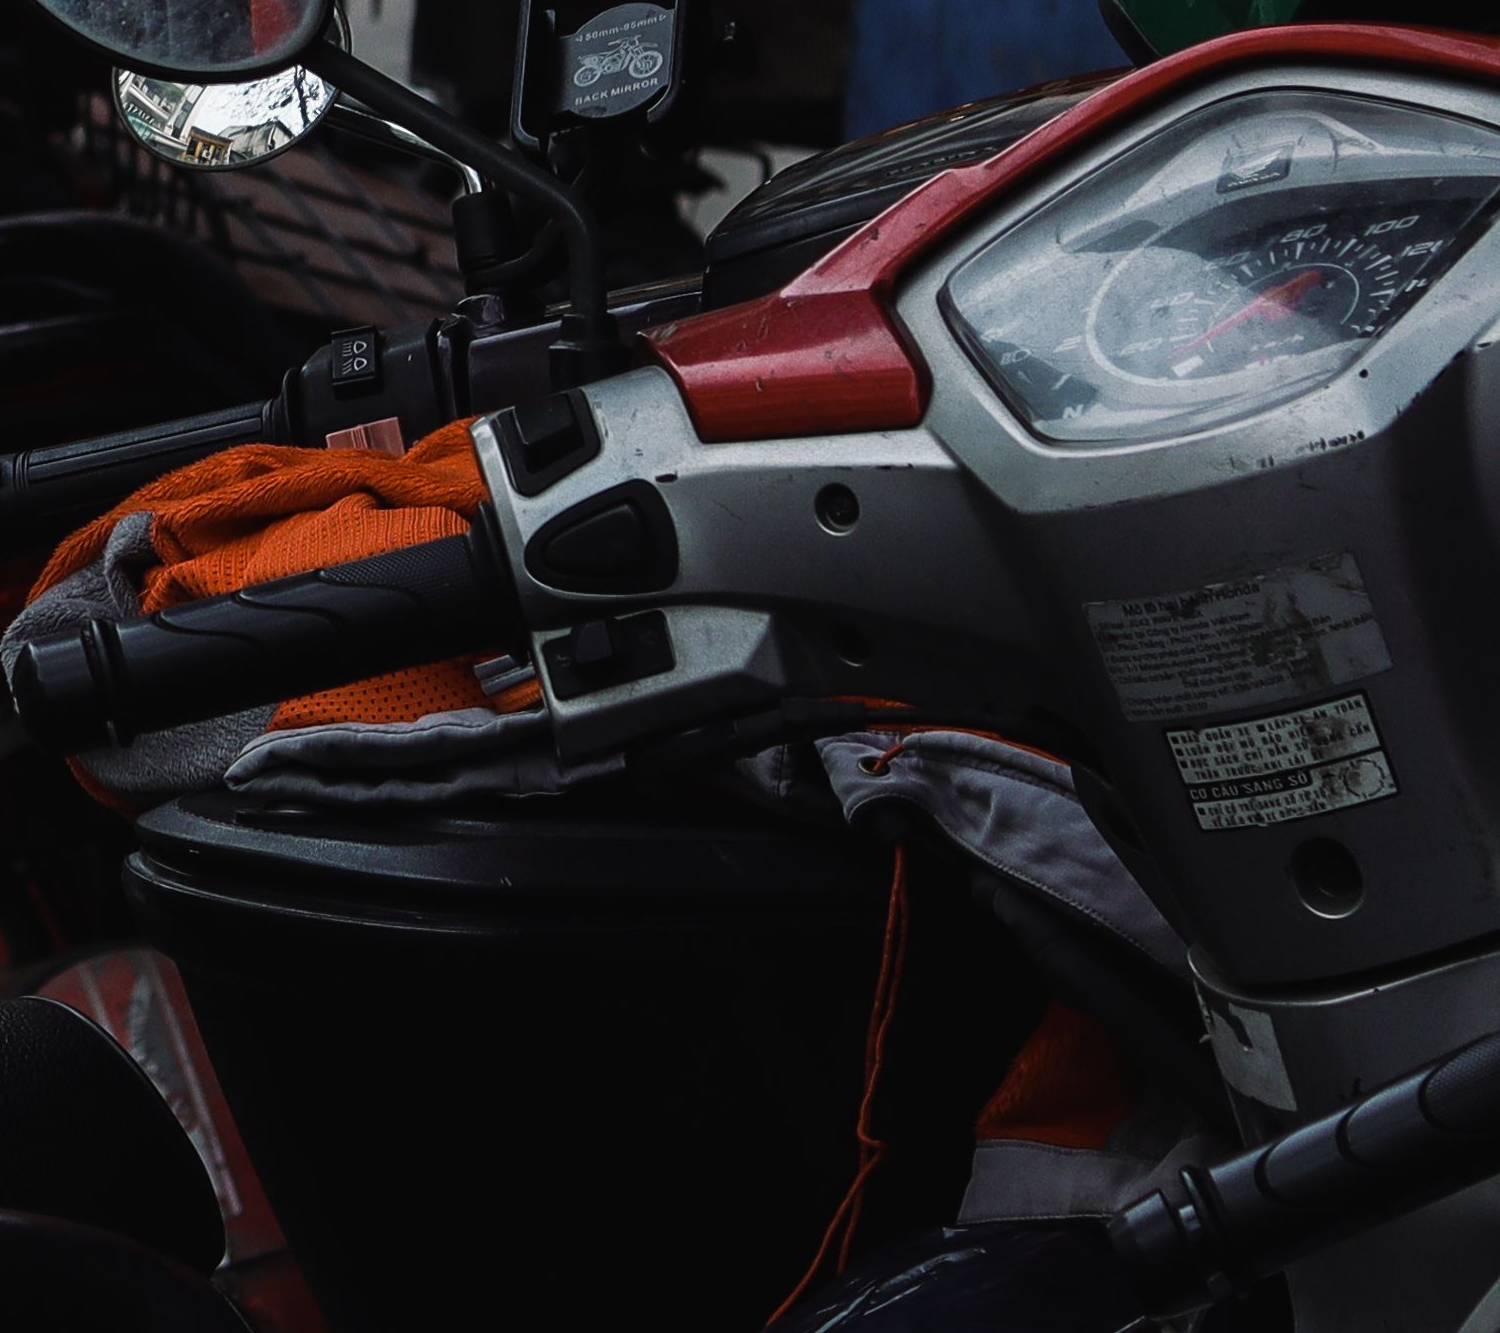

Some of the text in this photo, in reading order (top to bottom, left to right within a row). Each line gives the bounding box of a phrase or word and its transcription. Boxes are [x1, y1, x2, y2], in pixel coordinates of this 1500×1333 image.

[574, 76, 659, 106] BACK MIRROR
[1280, 224, 1328, 244] 80
[1364, 214, 1421, 237] 100
[1062, 404, 1084, 420] N
[1239, 777, 1284, 795] SANG
[1287, 768, 1309, 787] SỐ
